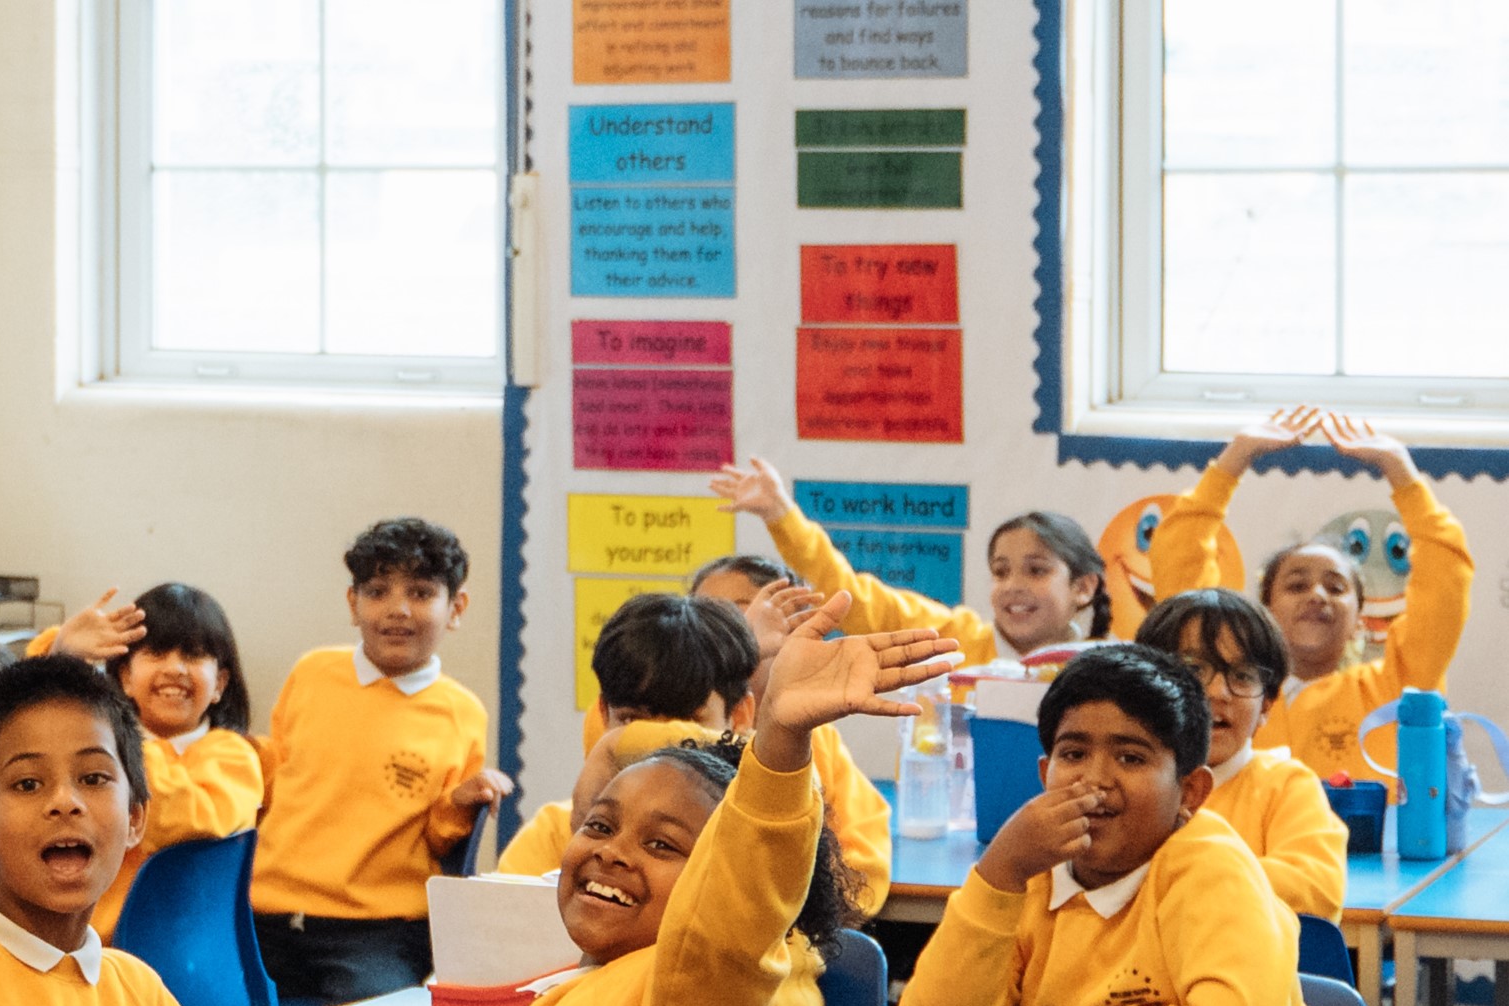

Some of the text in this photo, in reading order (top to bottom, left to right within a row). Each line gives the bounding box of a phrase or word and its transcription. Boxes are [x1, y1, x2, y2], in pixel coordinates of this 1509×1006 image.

[867, 0, 892, 16] for
[824, 27, 934, 48] and find ways
[818, 53, 836, 71] to
[840, 52, 895, 71] bounce
[590, 112, 714, 137] Understand
[616, 149, 687, 172] others
[575, 195, 731, 211] Listen to others who
[579, 223, 652, 241] encourage
[659, 221, 685, 236] and
[585, 244, 722, 267] thanking them for
[821, 254, 848, 275] To
[854, 256, 888, 281] try
[606, 273, 643, 287] their
[597, 329, 707, 360] To imagine
[809, 490, 957, 519] To work hard
[610, 505, 691, 532] To push
[605, 542, 694, 568] yourself
[857, 536, 884, 554] fun
[887, 538, 951, 563] working
[888, 566, 916, 583] and
